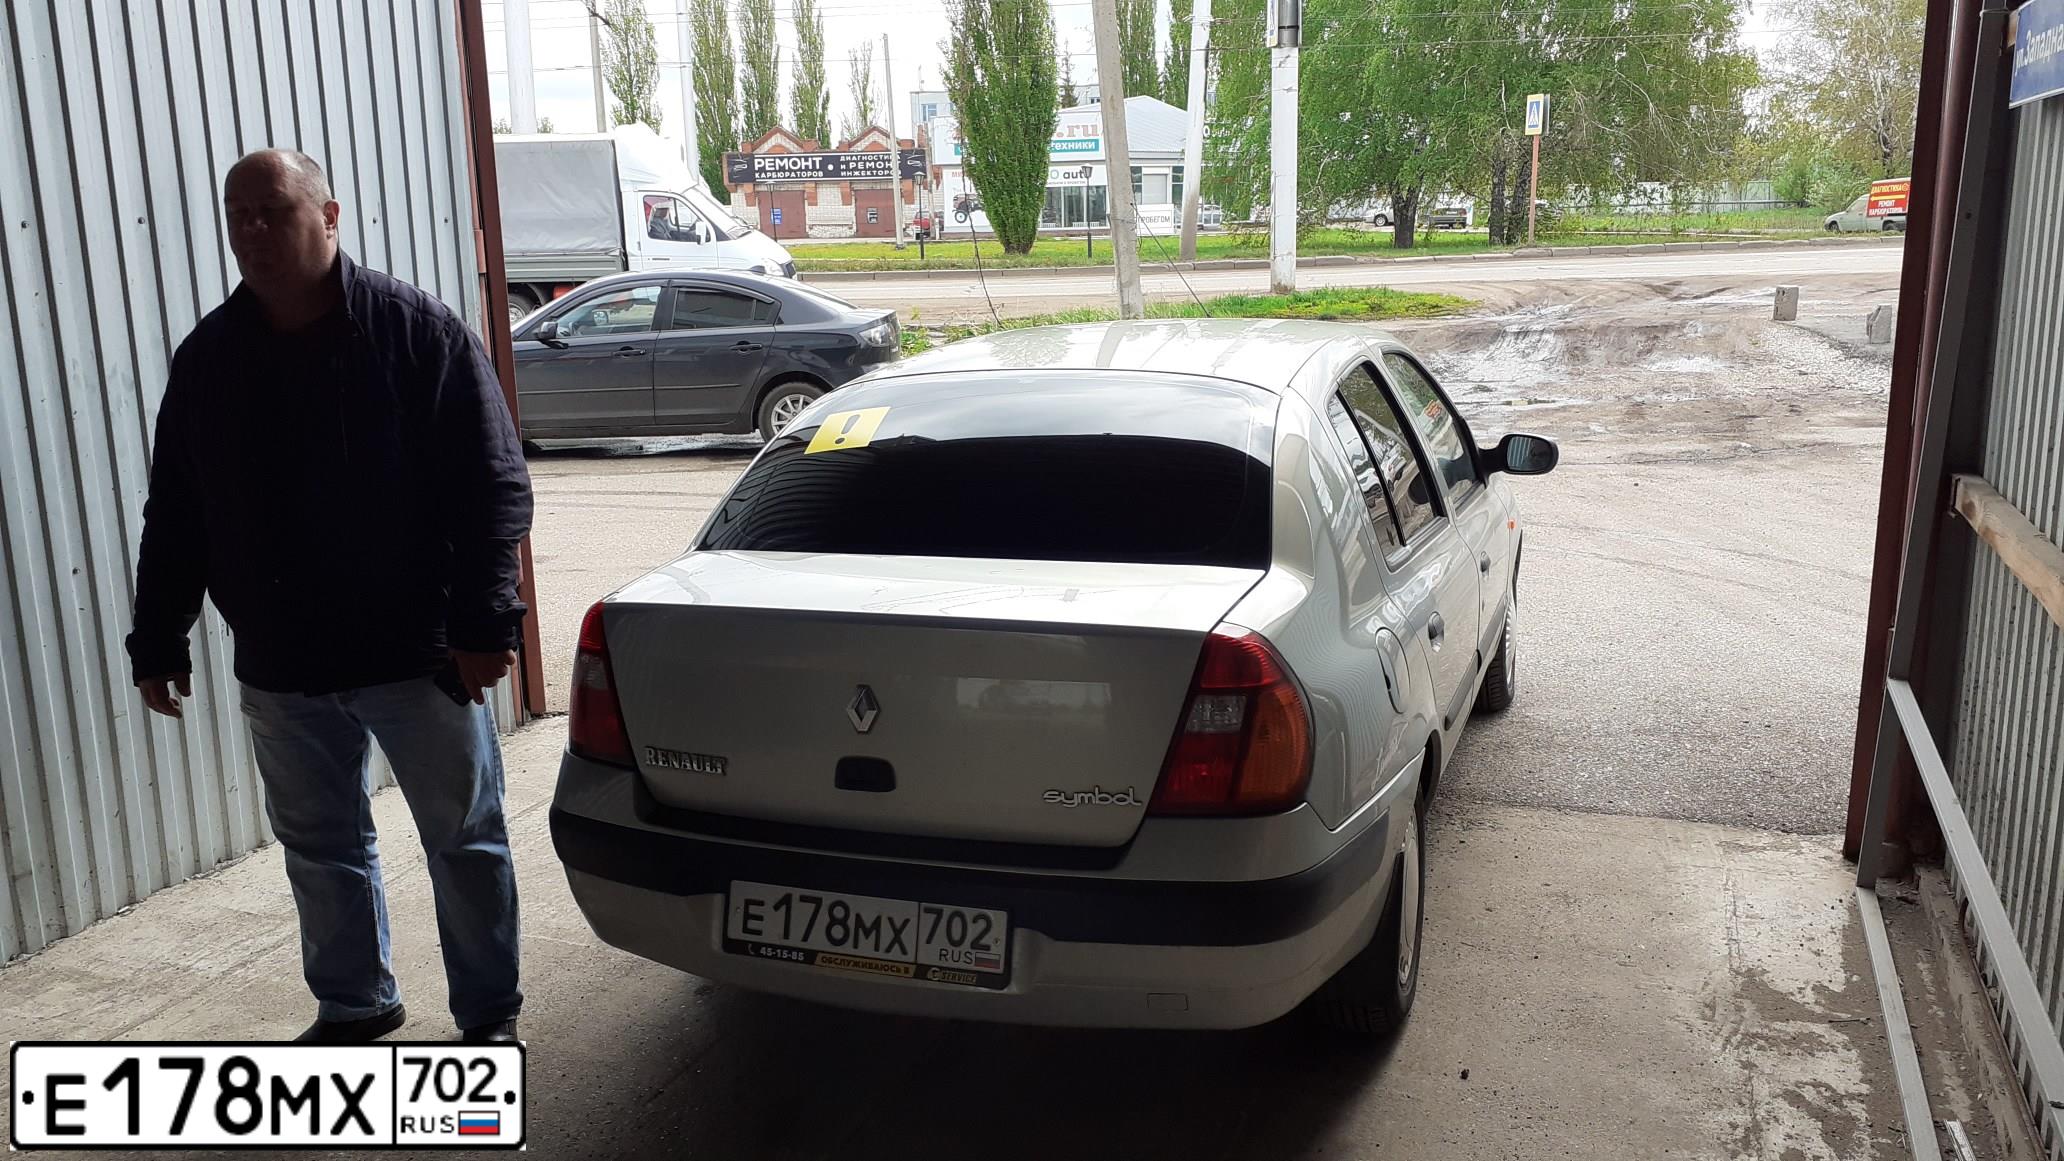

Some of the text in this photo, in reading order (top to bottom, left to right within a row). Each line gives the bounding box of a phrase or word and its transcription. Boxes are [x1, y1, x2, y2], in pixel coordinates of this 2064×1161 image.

[754, 157, 823, 171] РЕМОНТ
[755, 171, 824, 179] КАРБЮРАТОРОВ
[644, 746, 727, 775] RENAULT
[1042, 785, 1142, 808] symbol
[922, 905, 993, 951] 702
[759, 946, 805, 962] 45-15-85
[938, 948, 974, 965] RUS
[820, 955, 902, 974] ОБСЛУЖИВАЮСЬ
